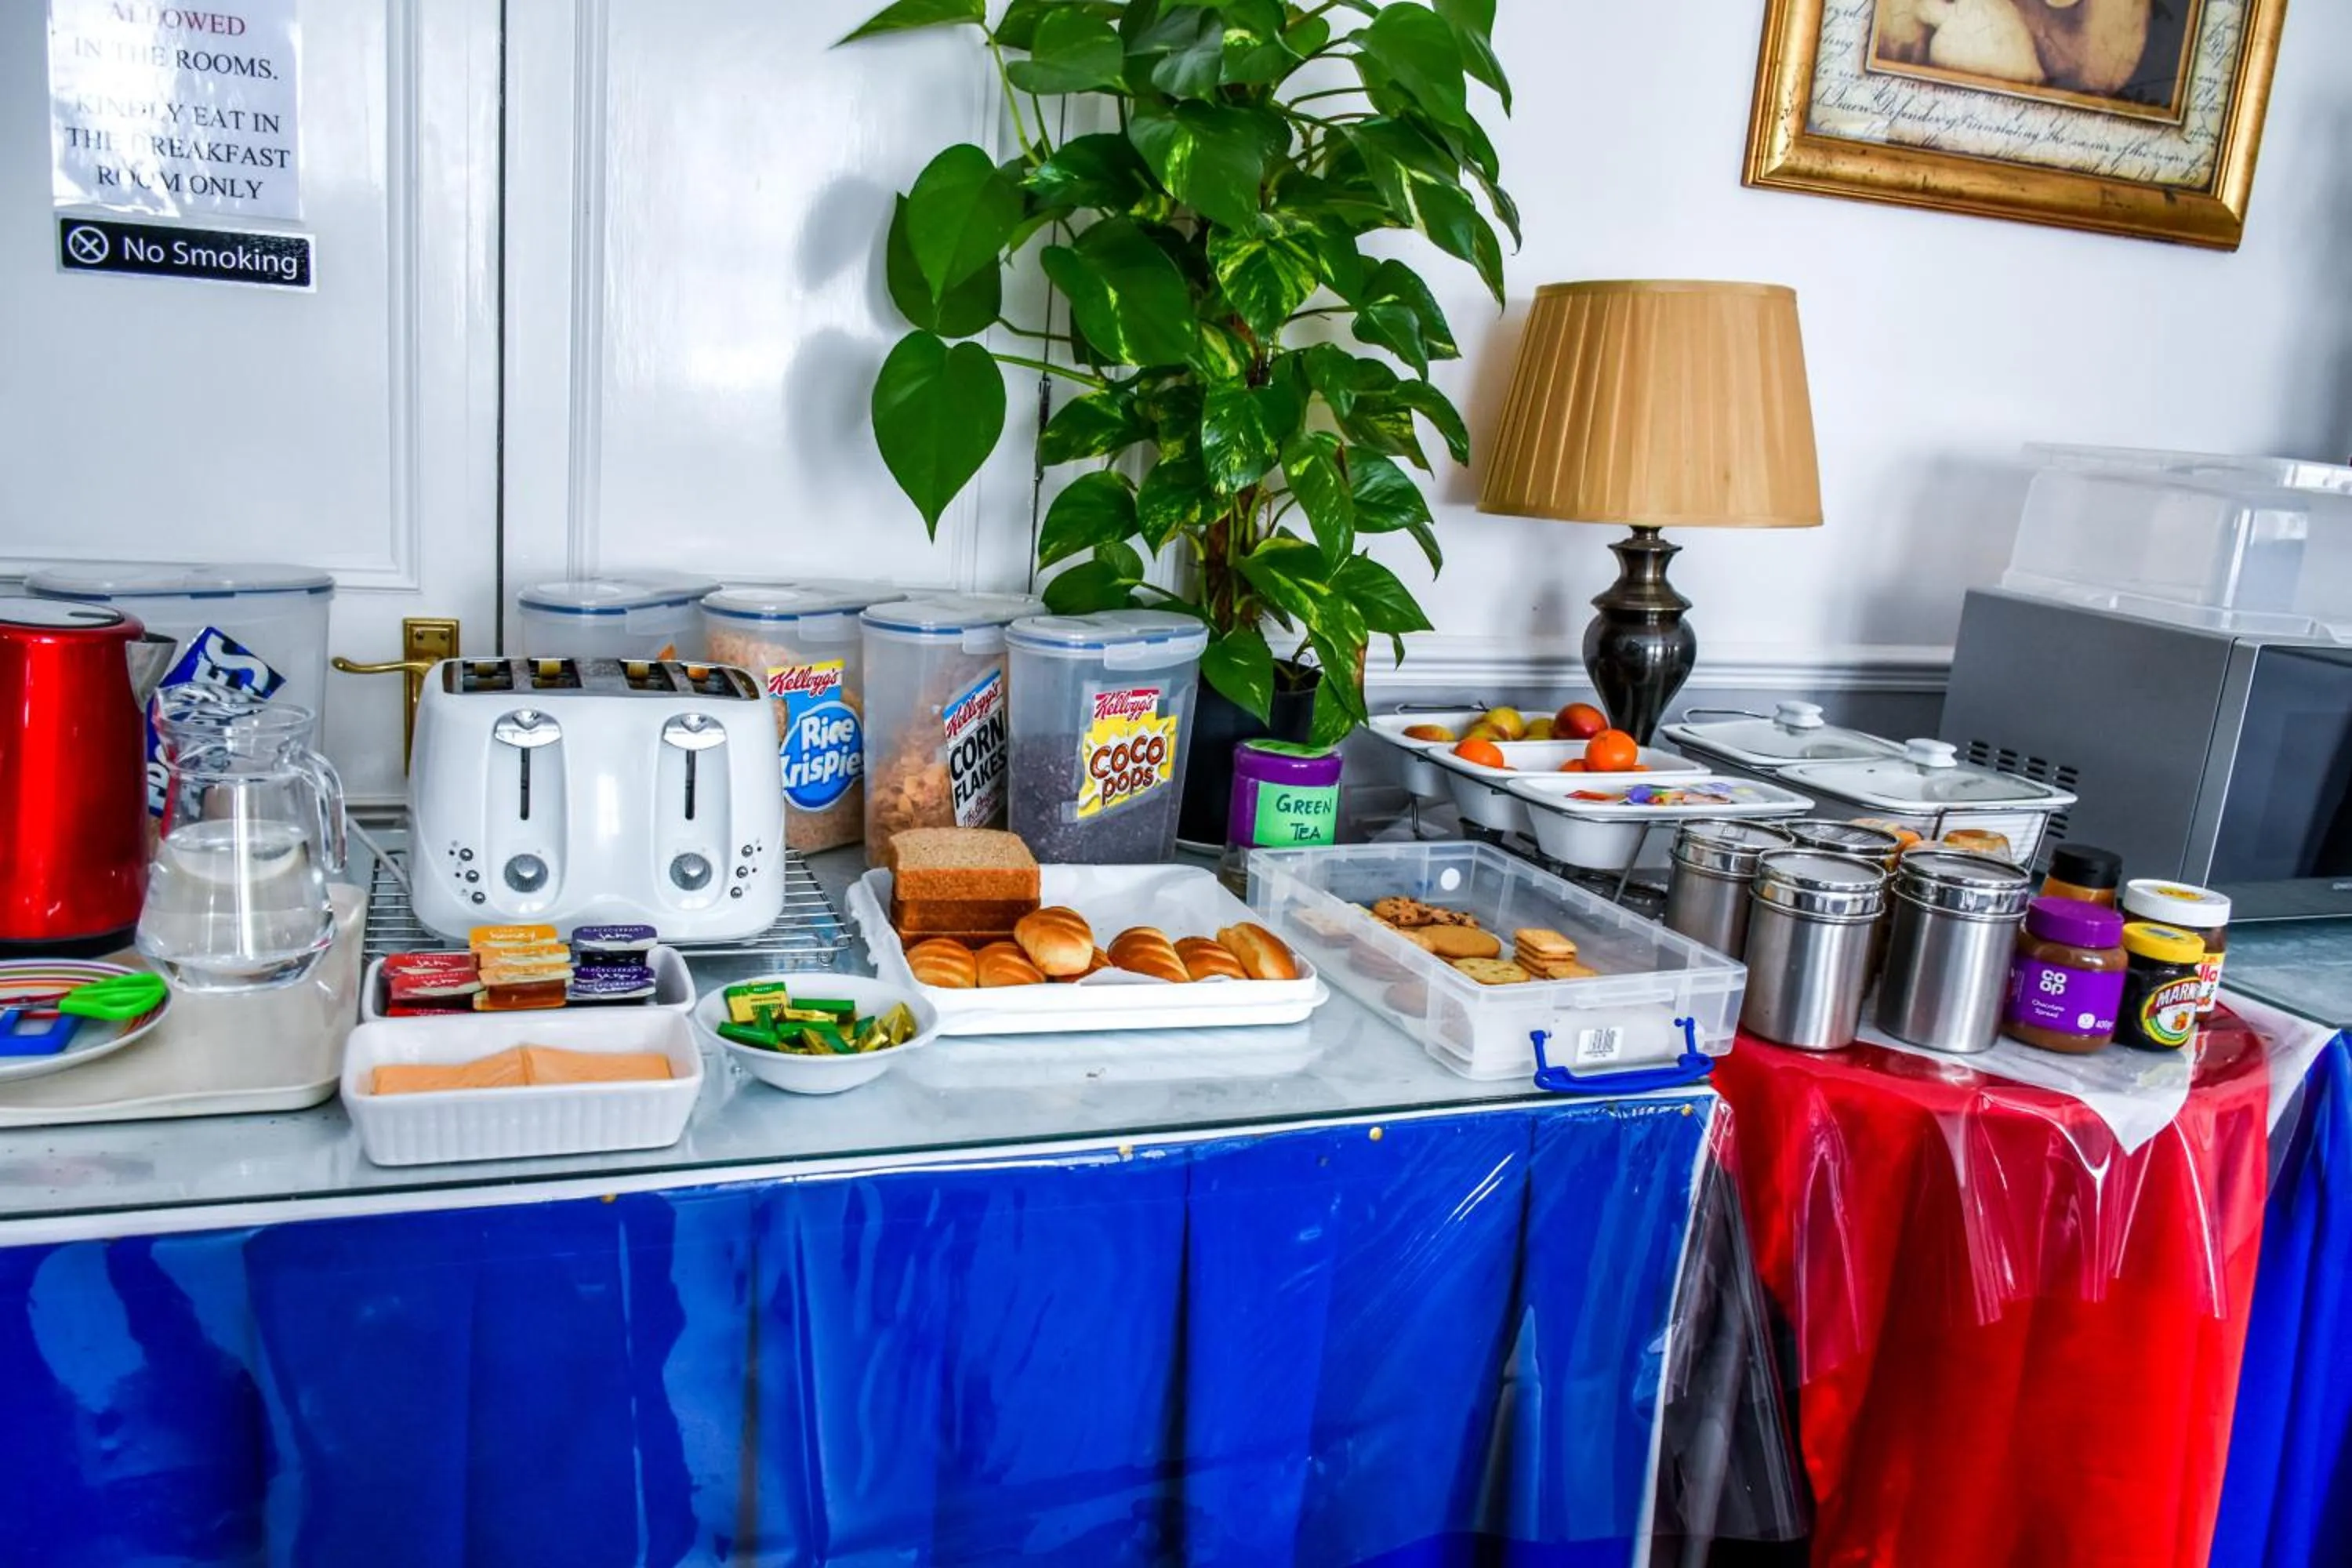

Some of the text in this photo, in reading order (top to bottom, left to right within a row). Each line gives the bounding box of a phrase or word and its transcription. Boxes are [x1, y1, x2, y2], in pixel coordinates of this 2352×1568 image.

[176, 49, 279, 81] ROOMS.
[194, 106, 245, 130] EAT
[253, 112, 282, 134] IN
[189, 174, 265, 201] ONLY
[123, 237, 299, 280] No Smoking
[768, 666, 839, 696] Kellogg's
[947, 681, 1000, 739] Kellogg's
[1094, 691, 1154, 721] Kellogg's
[801, 716, 855, 750] Rice
[950, 710, 1005, 781] CORN
[1090, 735, 1166, 779] COCO
[954, 745, 1008, 809] FLAKES
[1276, 793, 1332, 815] GREEN
[1290, 822, 1321, 841] TEA
